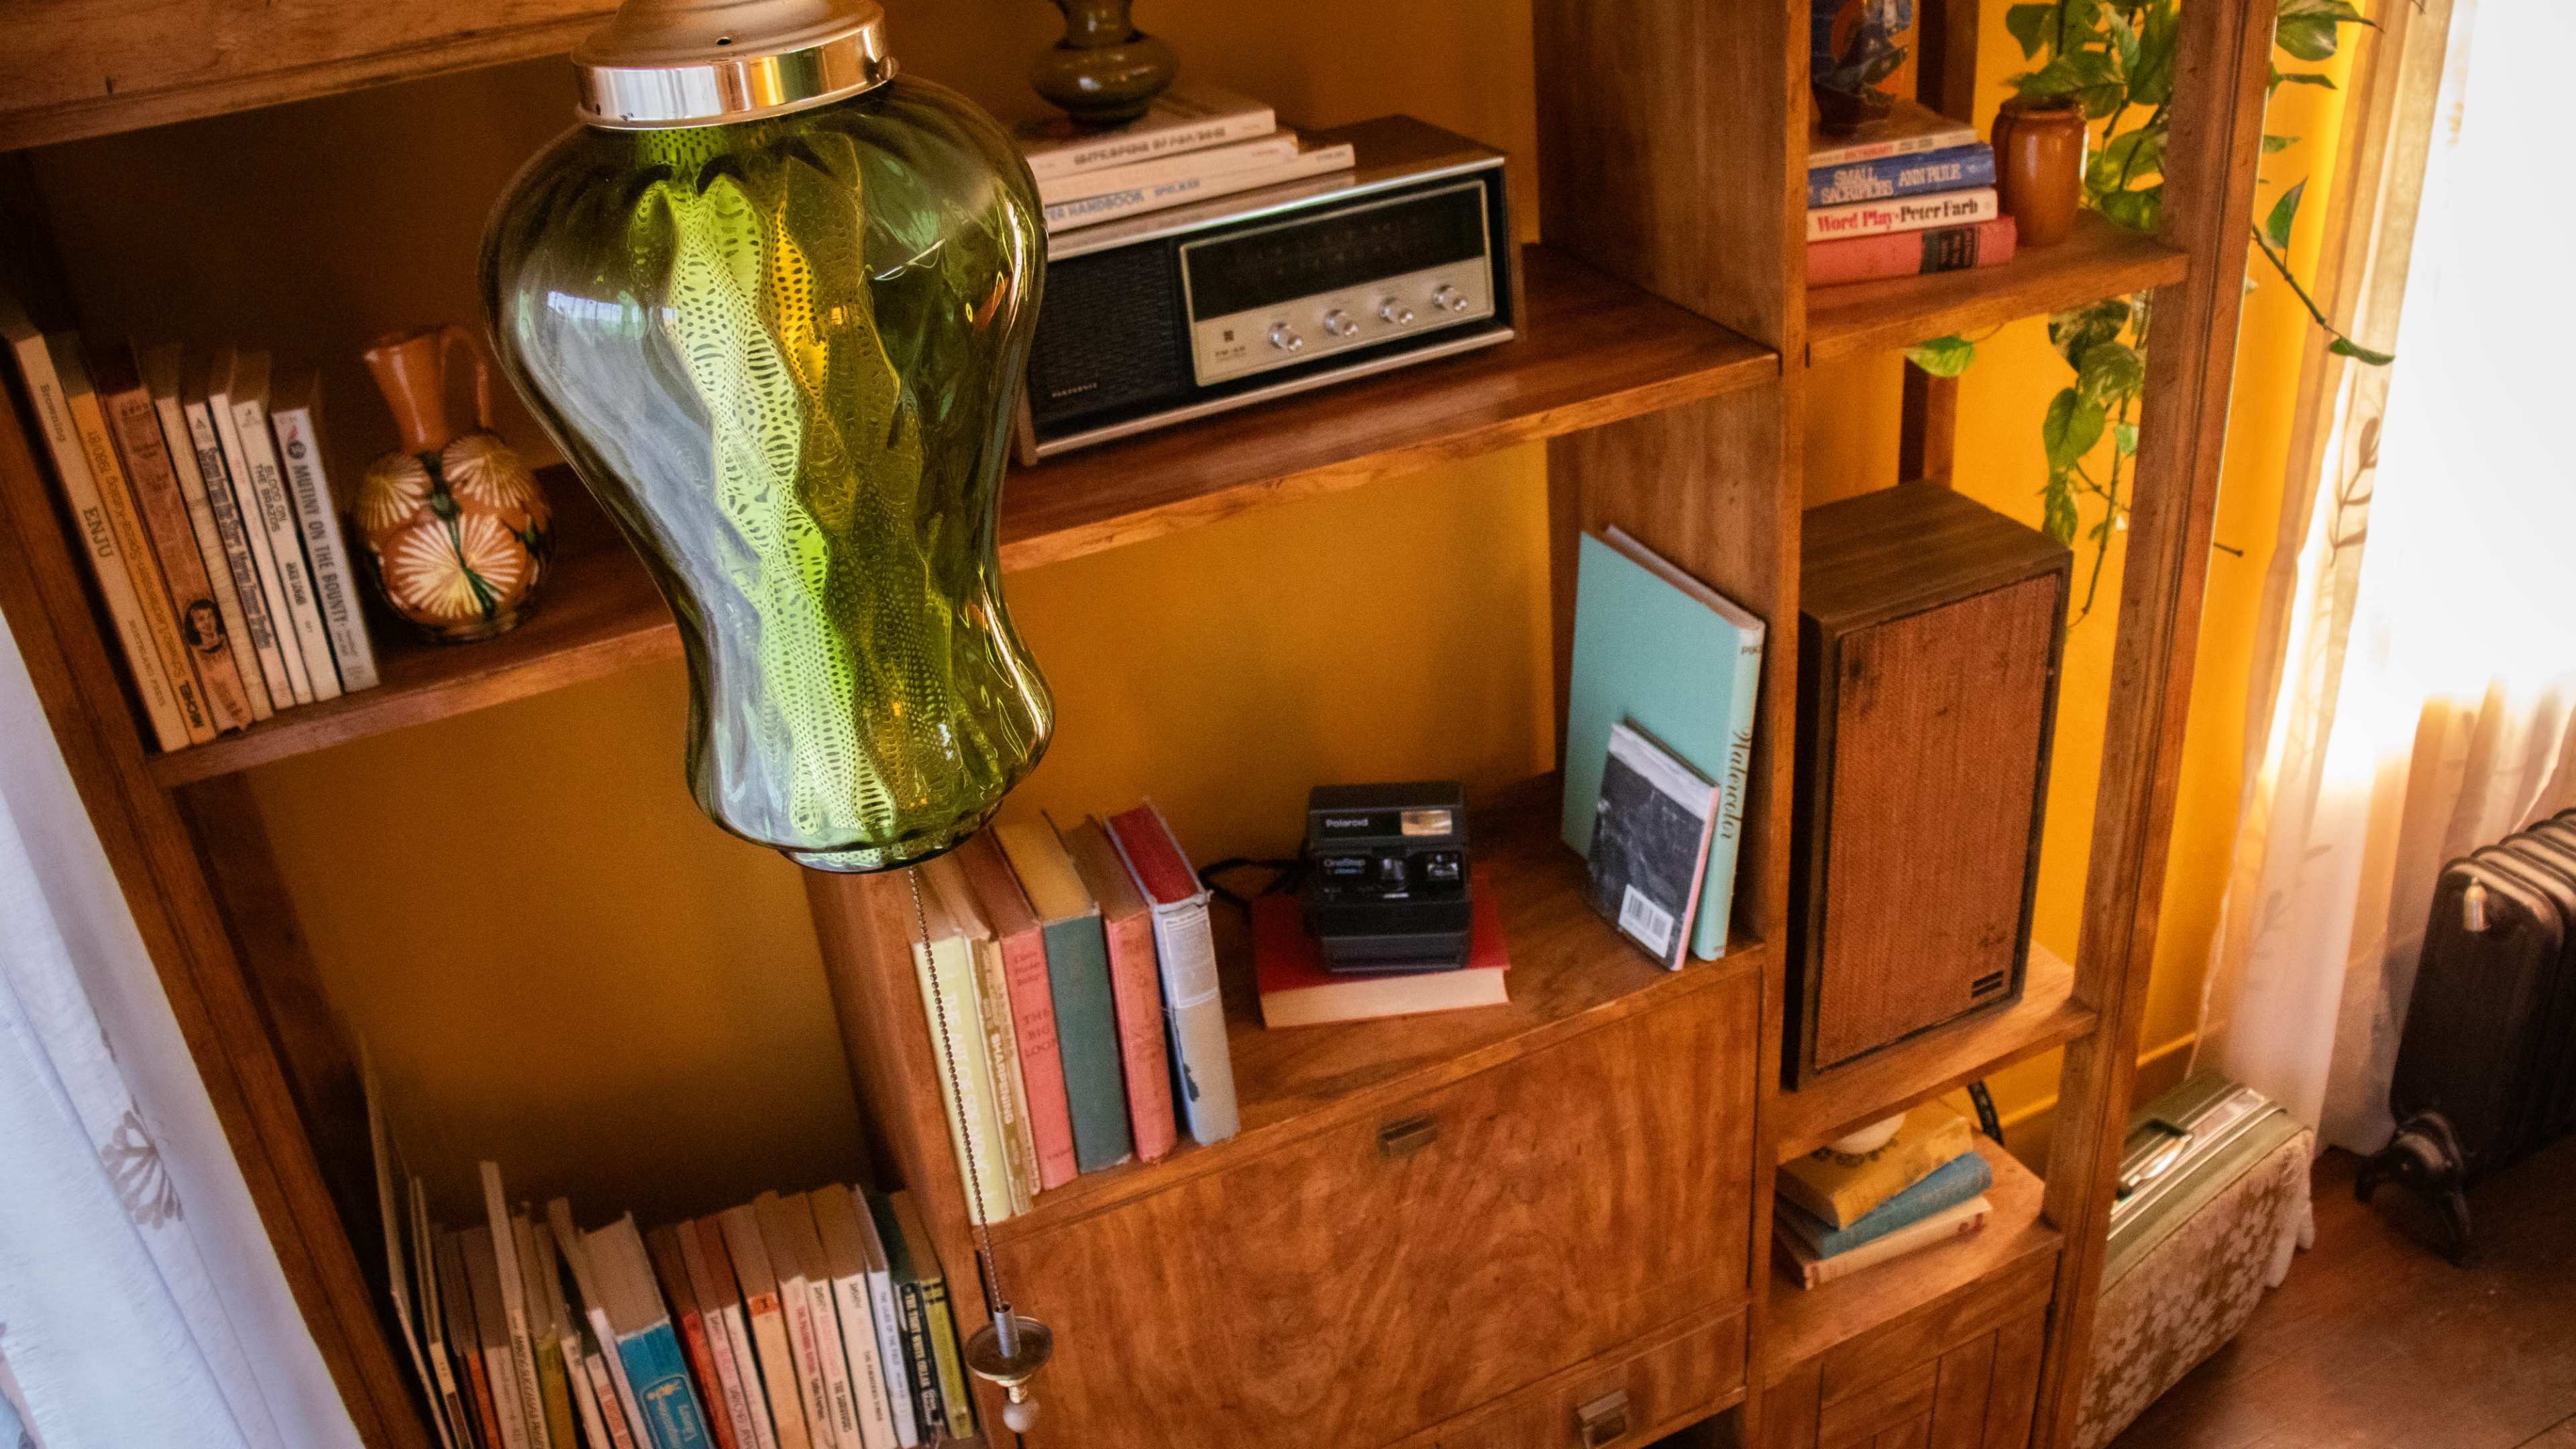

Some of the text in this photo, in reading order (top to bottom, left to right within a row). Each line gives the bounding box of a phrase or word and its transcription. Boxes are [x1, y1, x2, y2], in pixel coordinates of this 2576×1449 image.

[1833, 164, 1876, 187] SMALL
[1896, 162, 1962, 187] ANN RULE
[1067, 187, 1144, 219] HANDBOOK
[1817, 195, 1979, 233] Word Play Peter Farb
[38, 383, 69, 443] Browning
[253, 463, 280, 533] THE BRAZOS
[263, 464, 288, 523] BLOOD ON
[290, 462, 323, 520] MUTINY
[82, 505, 115, 560] ENJU
[306, 518, 329, 541] ON
[313, 544, 337, 570] THE
[320, 572, 352, 626] BOUNTY
[1719, 727, 1752, 839] Watercolor
[1325, 818, 1369, 828] Polaroid
[940, 991, 962, 1027] THE
[1022, 1009, 1050, 1024] THE
[948, 1031, 970, 1065] ART
[954, 1064, 975, 1090] OF
[988, 1032, 1016, 1124] SHARPENING
[879, 1291, 888, 1303] THE
[904, 1293, 917, 1310] THE
[885, 1325, 893, 1333] OF
[888, 1336, 896, 1346] THE
[890, 1348, 899, 1365] FIELD
[910, 1334, 926, 1360] WHITE
[915, 1359, 931, 1387] COLLAR
